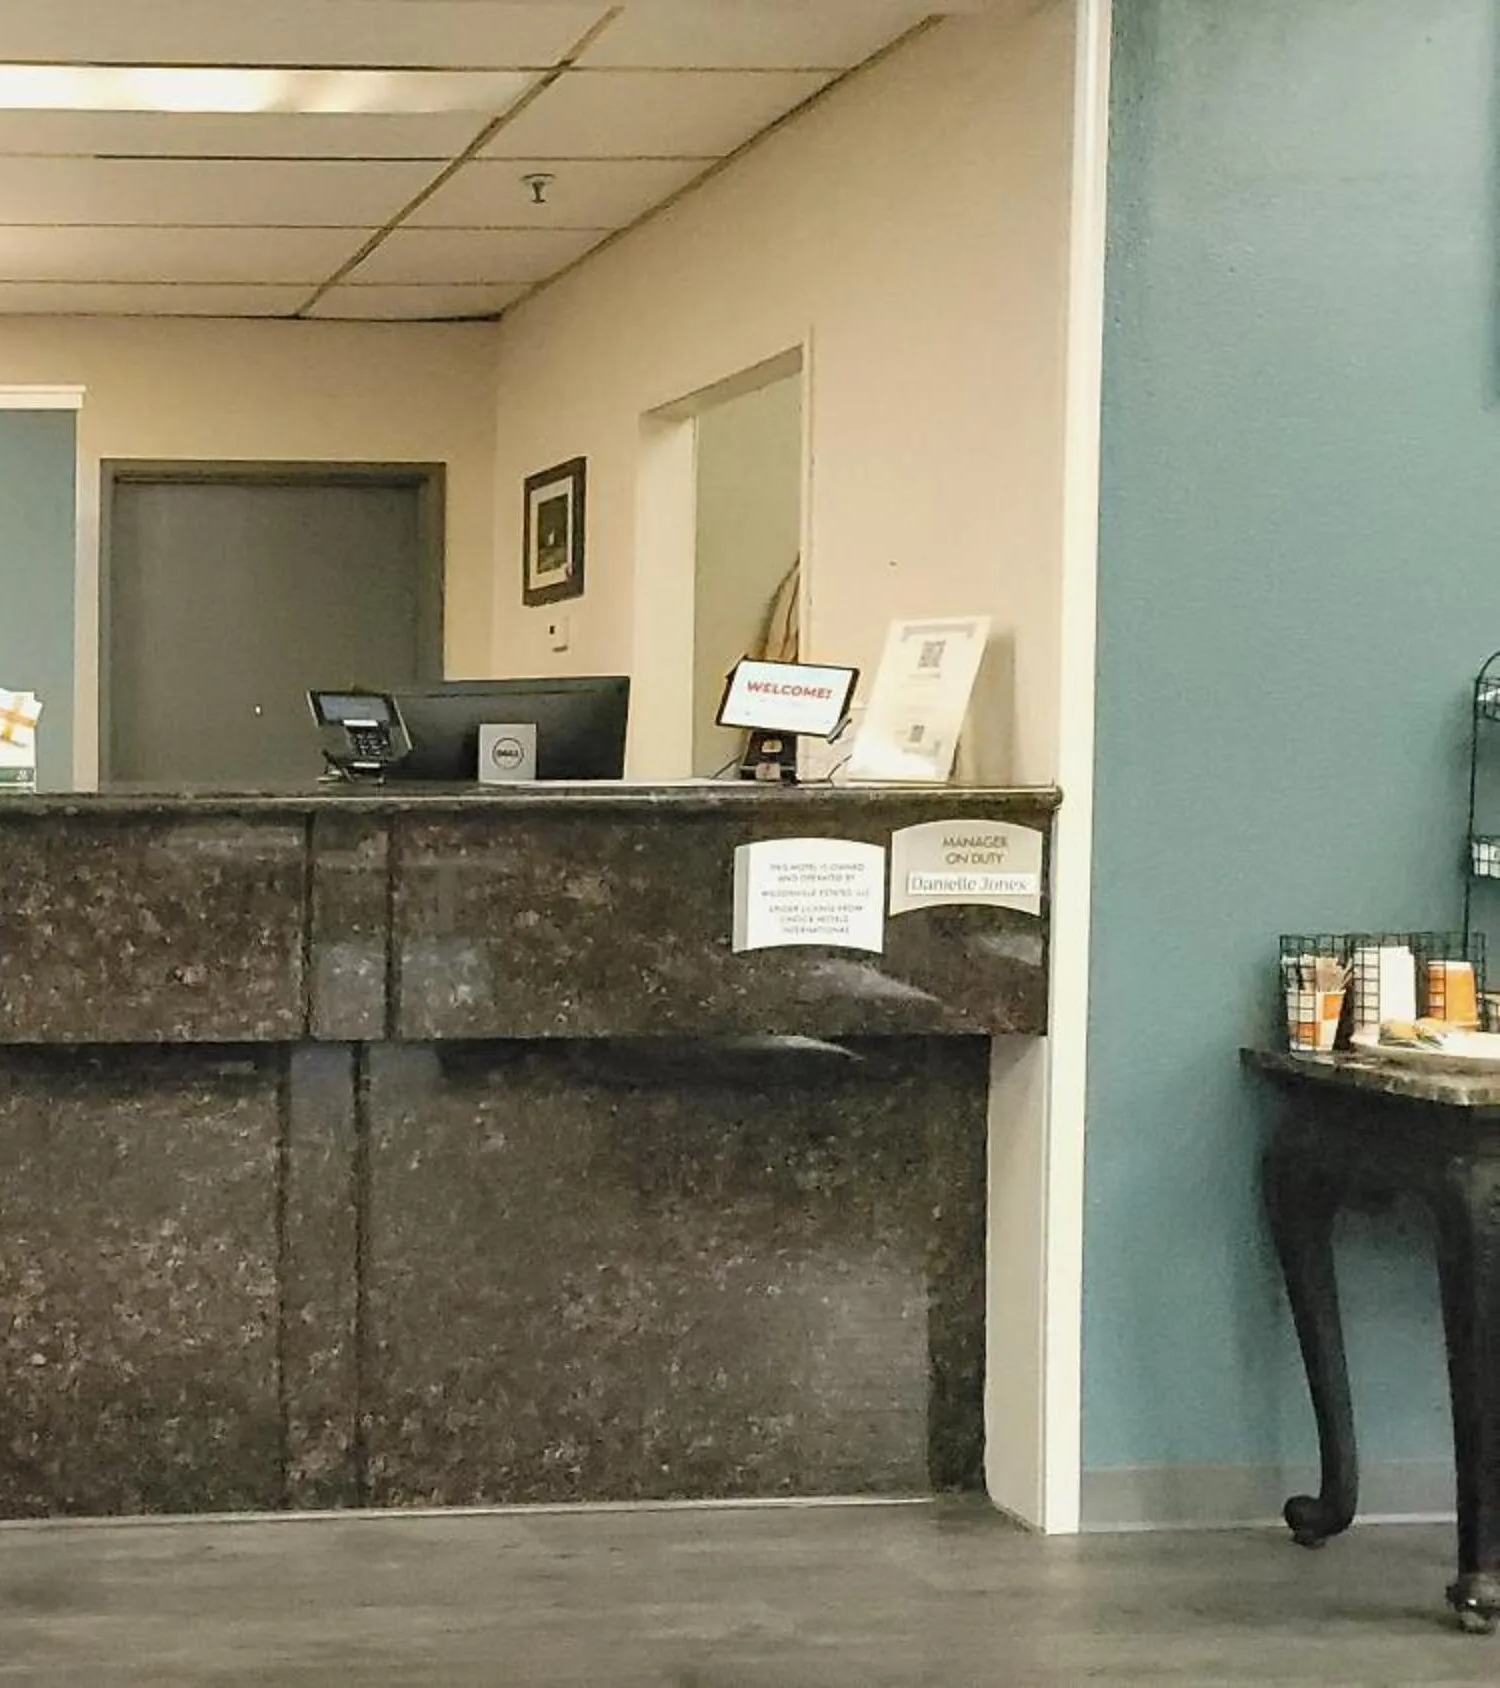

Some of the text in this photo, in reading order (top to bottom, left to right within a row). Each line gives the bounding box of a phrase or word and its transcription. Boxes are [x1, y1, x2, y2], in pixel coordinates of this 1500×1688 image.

[747, 680, 833, 700] WELCOME!
[942, 835, 1008, 848] MANAGER
[945, 852, 1005, 865] ON DUTY
[911, 876, 1028, 891] Danielle Jones
